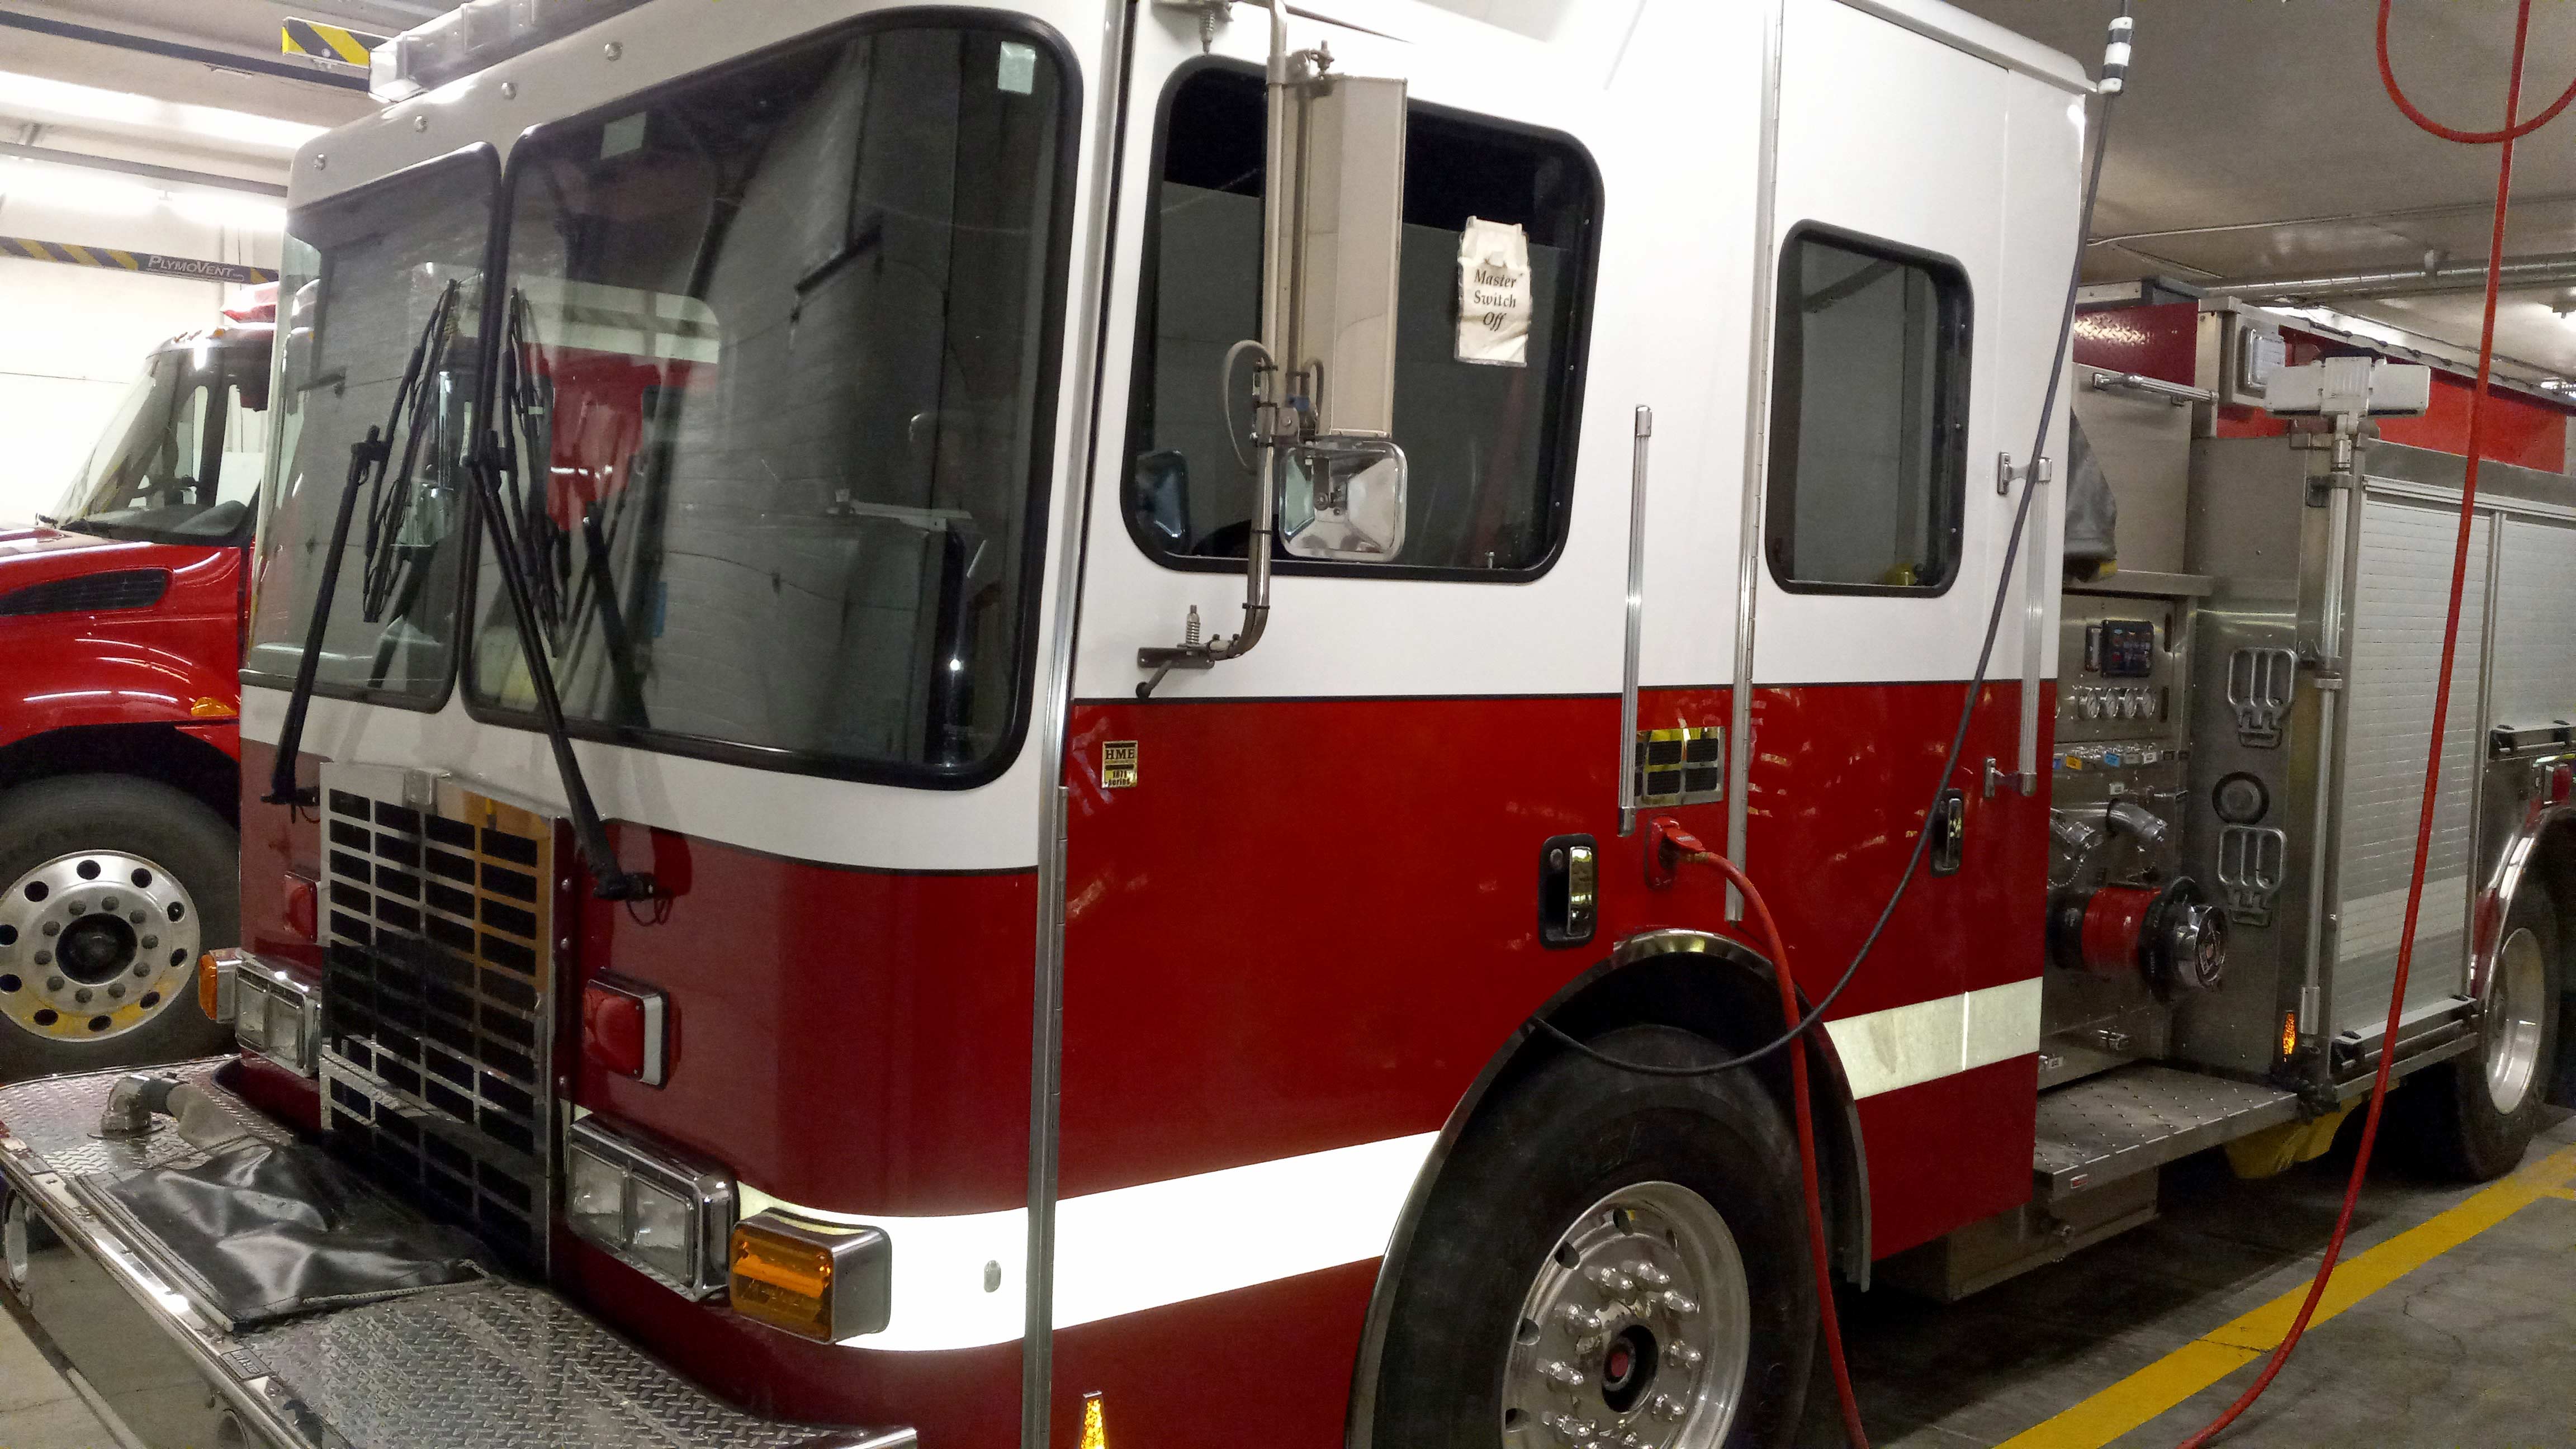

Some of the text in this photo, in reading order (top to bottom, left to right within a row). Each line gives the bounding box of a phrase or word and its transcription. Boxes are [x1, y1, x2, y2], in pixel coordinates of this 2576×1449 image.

[1474, 269, 1517, 288] Master
[1474, 290, 1517, 308] Switch
[1483, 312, 1507, 332] Off
[1105, 749, 1135, 759] HME
